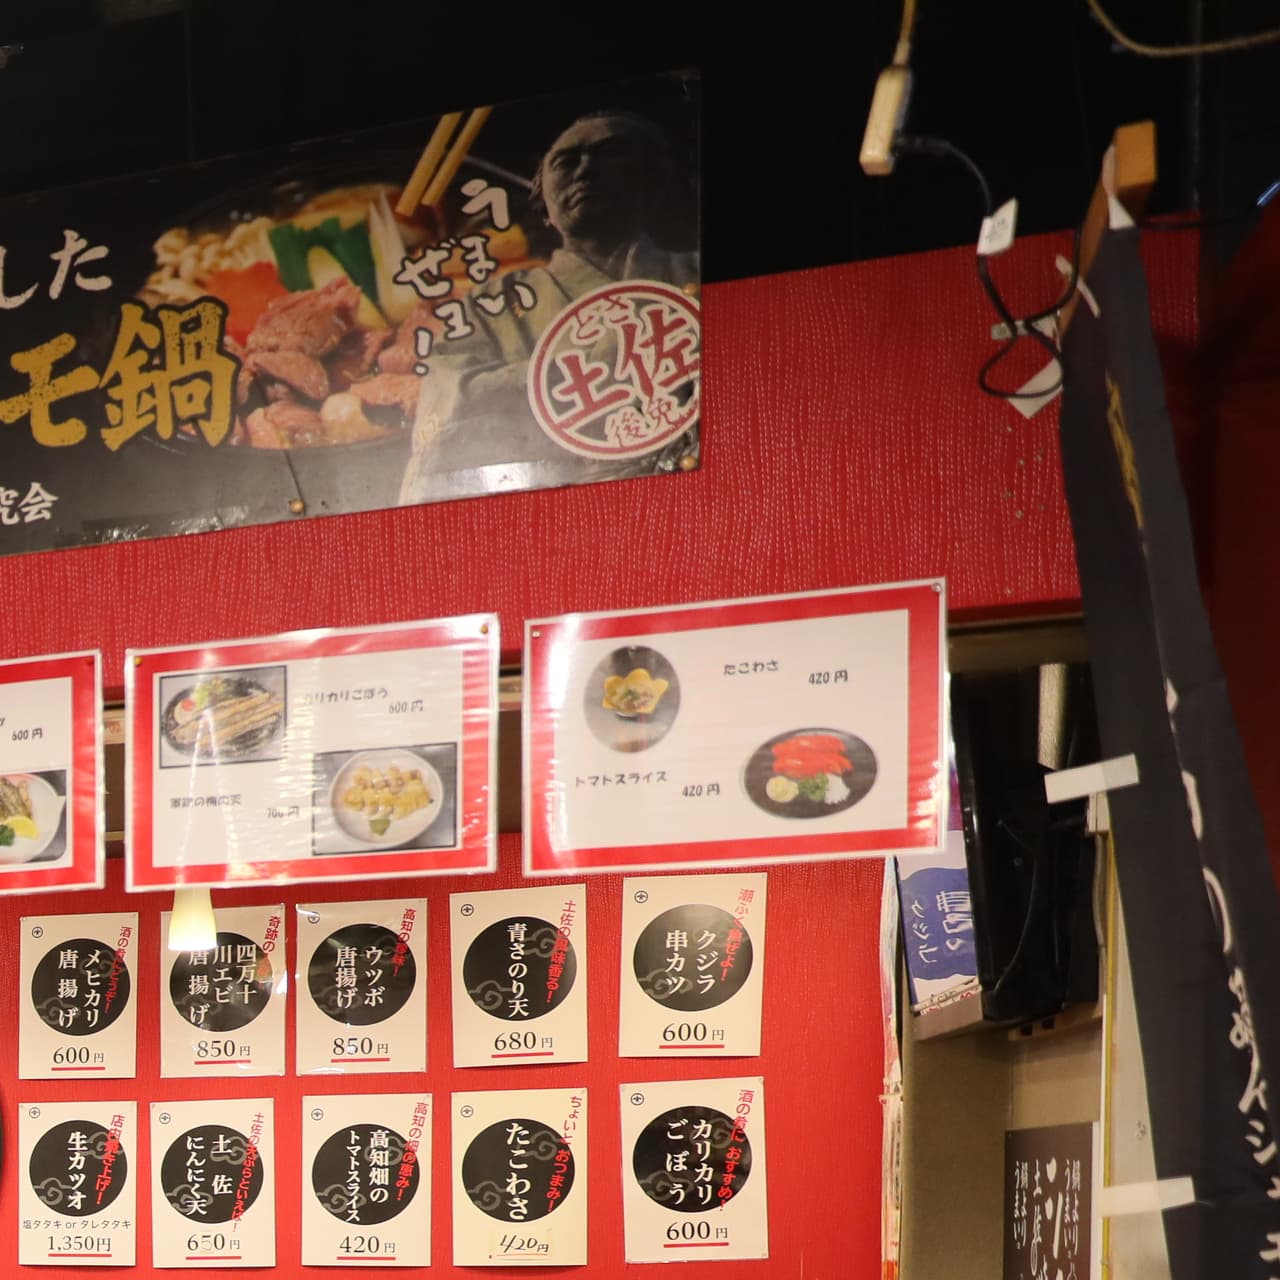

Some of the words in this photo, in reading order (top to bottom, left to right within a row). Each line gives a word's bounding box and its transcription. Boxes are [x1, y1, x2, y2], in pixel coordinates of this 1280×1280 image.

[552, 302, 699, 424] 土佐
[723, 659, 780, 675] たこわさ
[808, 670, 849, 685] 420円
[12, 726, 44, 742] 600円
[575, 770, 668, 788] トマトスライス
[681, 782, 720, 798] 420円
[58, 950, 78, 1028] 唐揚げ
[85, 949, 101, 1028] メヒカリ
[189, 949, 210, 1026] 唐揚げ
[213, 946, 232, 1004] 川エビ
[237, 944, 257, 1004] 四万十
[336, 947, 356, 1009] 唐揚げ
[364, 947, 384, 1007] ウツボ
[507, 923, 529, 1017] 青さのり天
[665, 930, 688, 995] 串カツ
[696, 930, 718, 994] クジラ
[53, 1047, 105, 1064] 600円
[197, 1040, 251, 1058] 850円
[332, 1037, 389, 1055] 850円
[494, 1032, 553, 1051] 680円
[662, 1023, 725, 1042] 600円
[66, 1132, 87, 1210] 生カツオ
[186, 1135, 207, 1216] にんにく天
[211, 1135, 233, 1196] 土佐
[347, 1131, 361, 1223] トマトスライス
[370, 1130, 389, 1203] 高知畑の
[506, 1123, 531, 1220] たこわさ
[666, 1120, 689, 1205] ごぼう
[692, 1119, 714, 1205] カリカリ
[22, 1219, 62, 1230] 塩タタキ
[65, 1219, 76, 1230] or
[79, 1219, 131, 1230] タレタタキ
[47, 1235, 111, 1253] 1,350円
[187, 1233, 240, 1252] 650円
[339, 1235, 396, 1254] 420円
[499, 1234, 549, 1254] 420円
[666, 1222, 728, 1241] 600円
